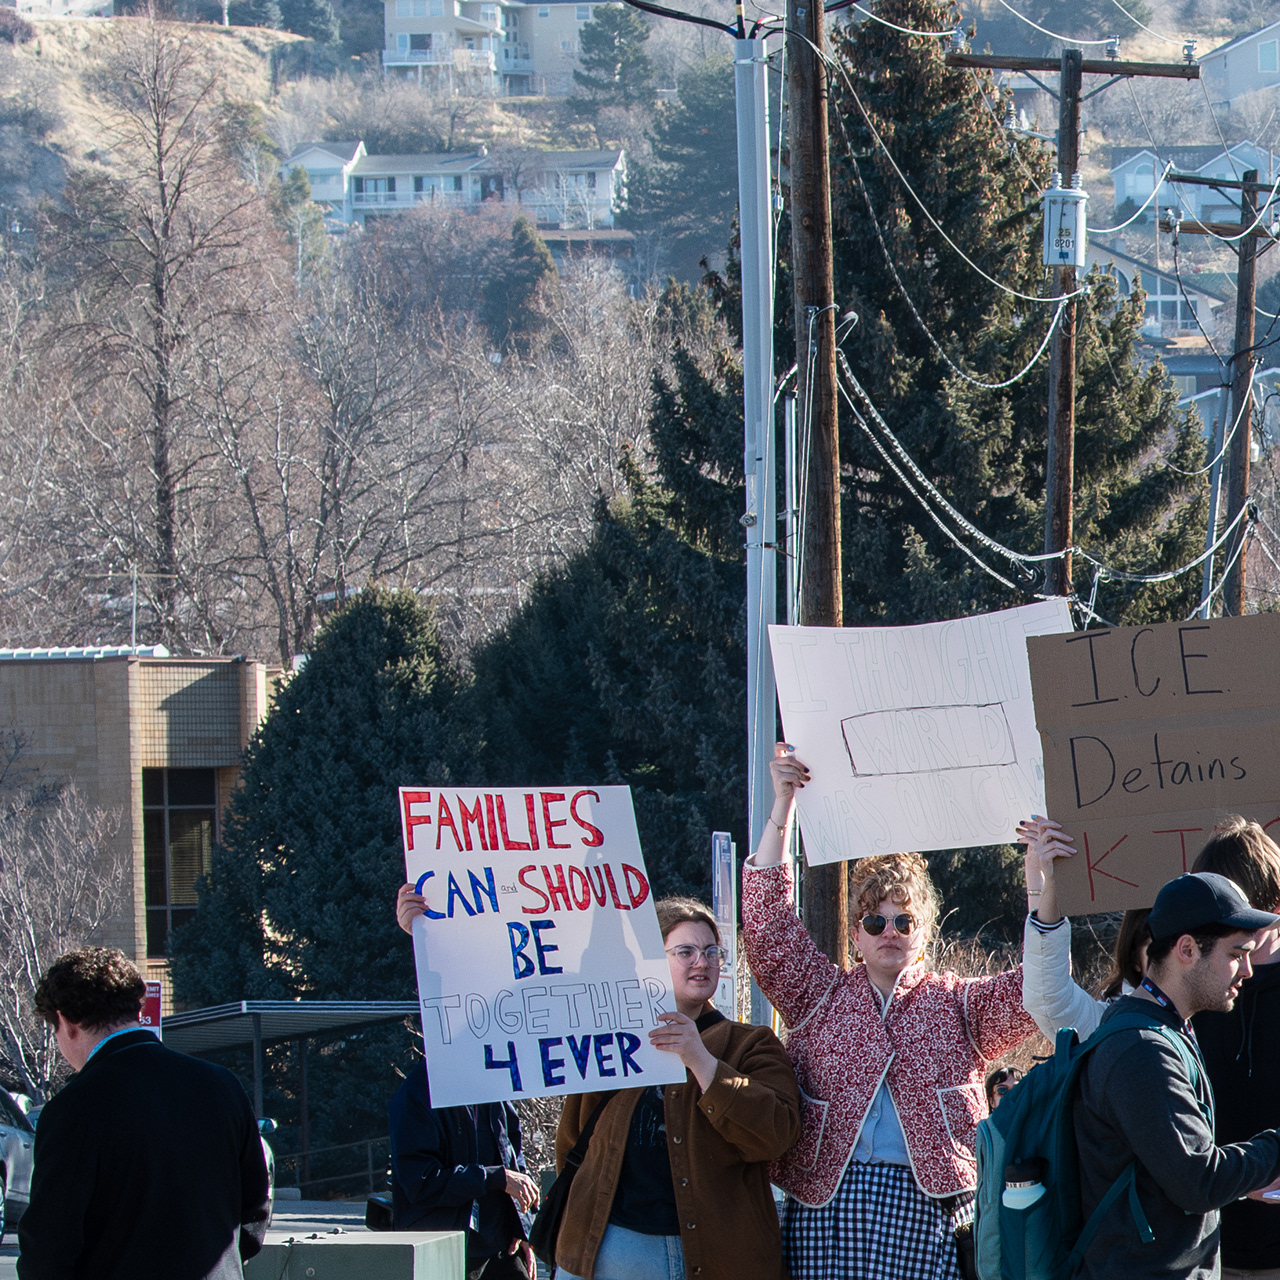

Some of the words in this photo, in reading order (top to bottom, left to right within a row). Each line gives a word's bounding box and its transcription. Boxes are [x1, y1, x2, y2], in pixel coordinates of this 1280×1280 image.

[777, 633, 828, 712] I
[834, 609, 1020, 712] THOUGHT
[1066, 626, 1231, 707] I.C.E.
[848, 704, 1008, 774] WORLD
[1069, 733, 1247, 809] Detains
[401, 790, 604, 851] FAMILIES
[797, 783, 892, 859] WAS
[895, 772, 979, 844] OUR
[415, 867, 500, 919] CAN
[501, 882, 518, 894] and
[518, 863, 650, 914] SHOULD
[506, 920, 563, 980] BE
[423, 977, 674, 1045] TOGETHER
[484, 1040, 524, 1092] 4
[538, 1031, 643, 1088] EVER
